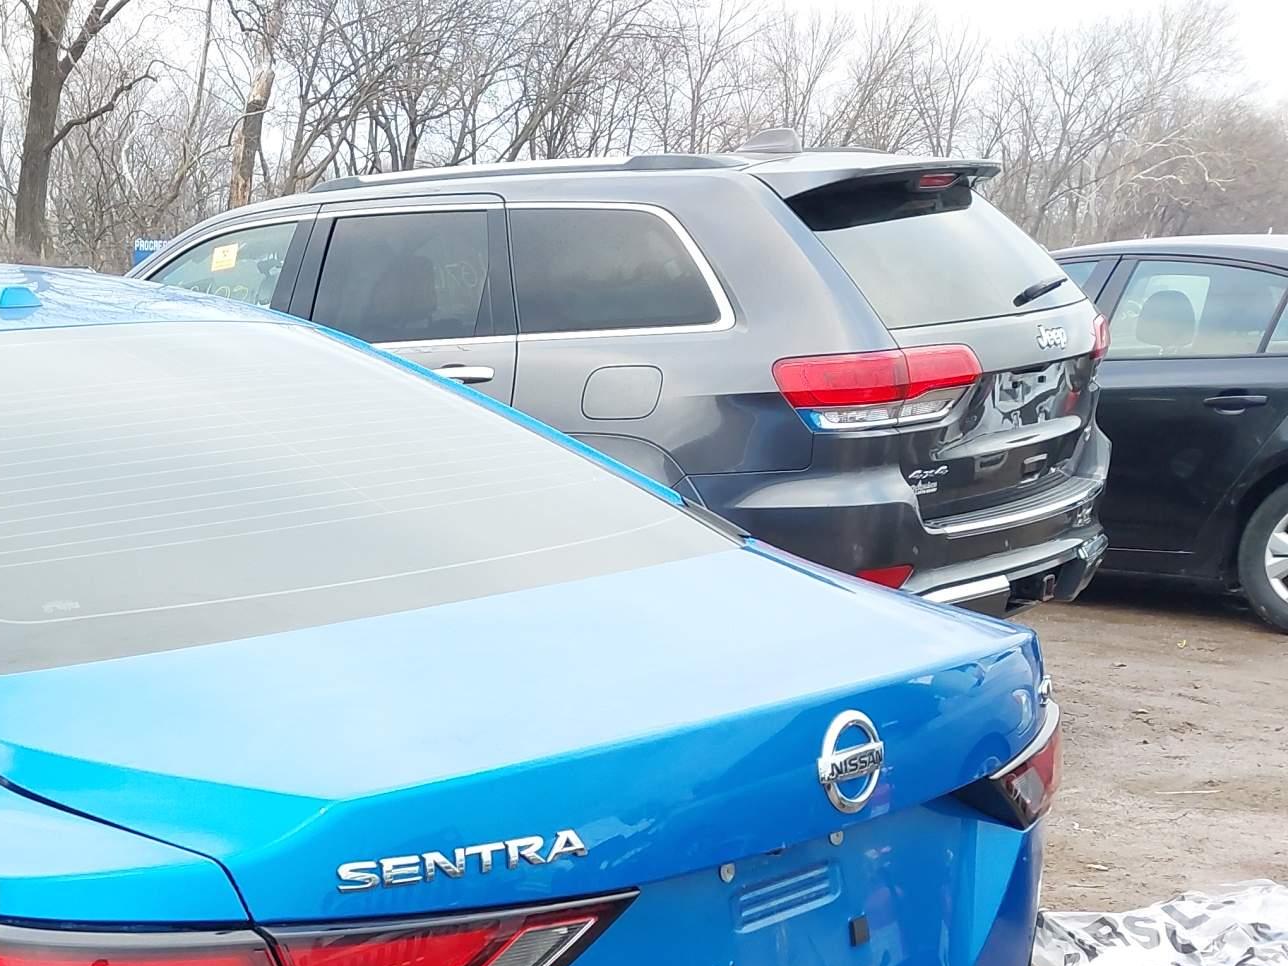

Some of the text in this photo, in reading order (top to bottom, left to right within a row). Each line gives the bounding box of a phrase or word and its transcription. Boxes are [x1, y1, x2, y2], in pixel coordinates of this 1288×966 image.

[1036, 324, 1067, 350] Jeep
[829, 748, 883, 777] NISSAN
[337, 828, 588, 893] SENTRA
